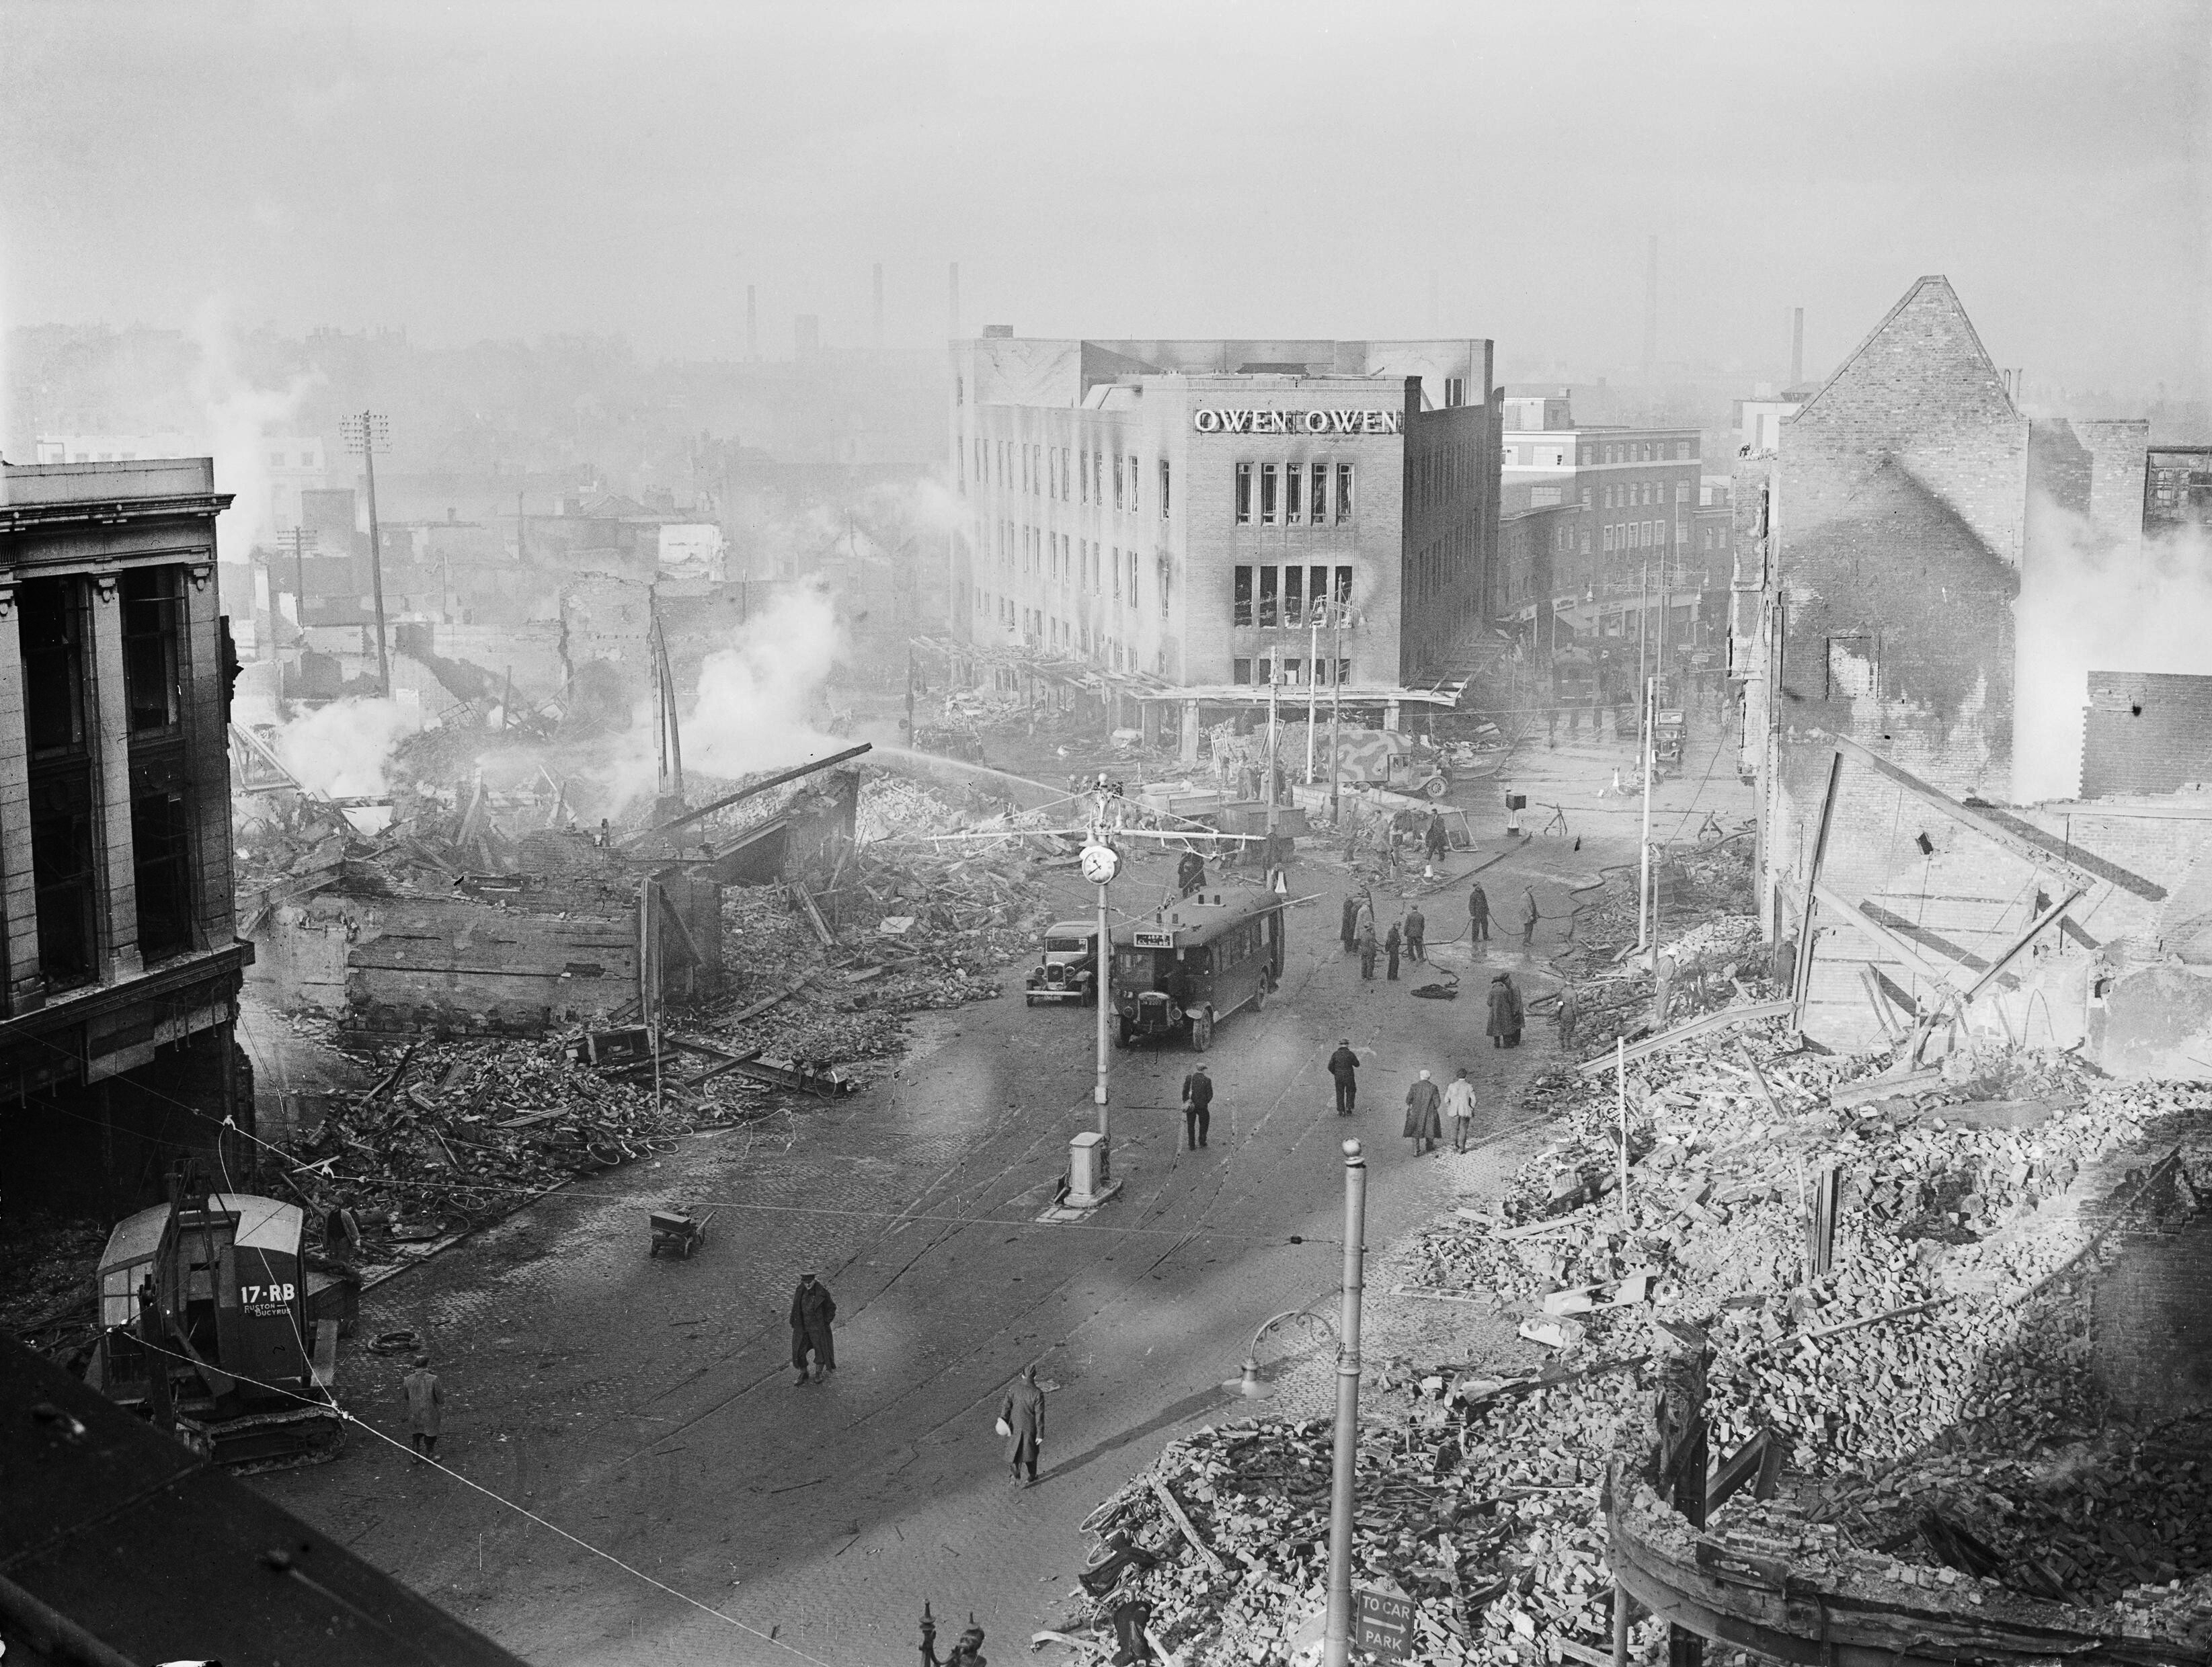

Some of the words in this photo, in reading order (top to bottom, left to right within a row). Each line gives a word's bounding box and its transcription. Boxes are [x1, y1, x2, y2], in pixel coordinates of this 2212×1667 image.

[1195, 409, 1291, 432] OWEN
[1305, 409, 1398, 433] OWEN
[1362, 1595, 1379, 1611] TO
[1382, 1602, 1410, 1620] CAR
[1366, 1630, 1402, 1652] PARK
